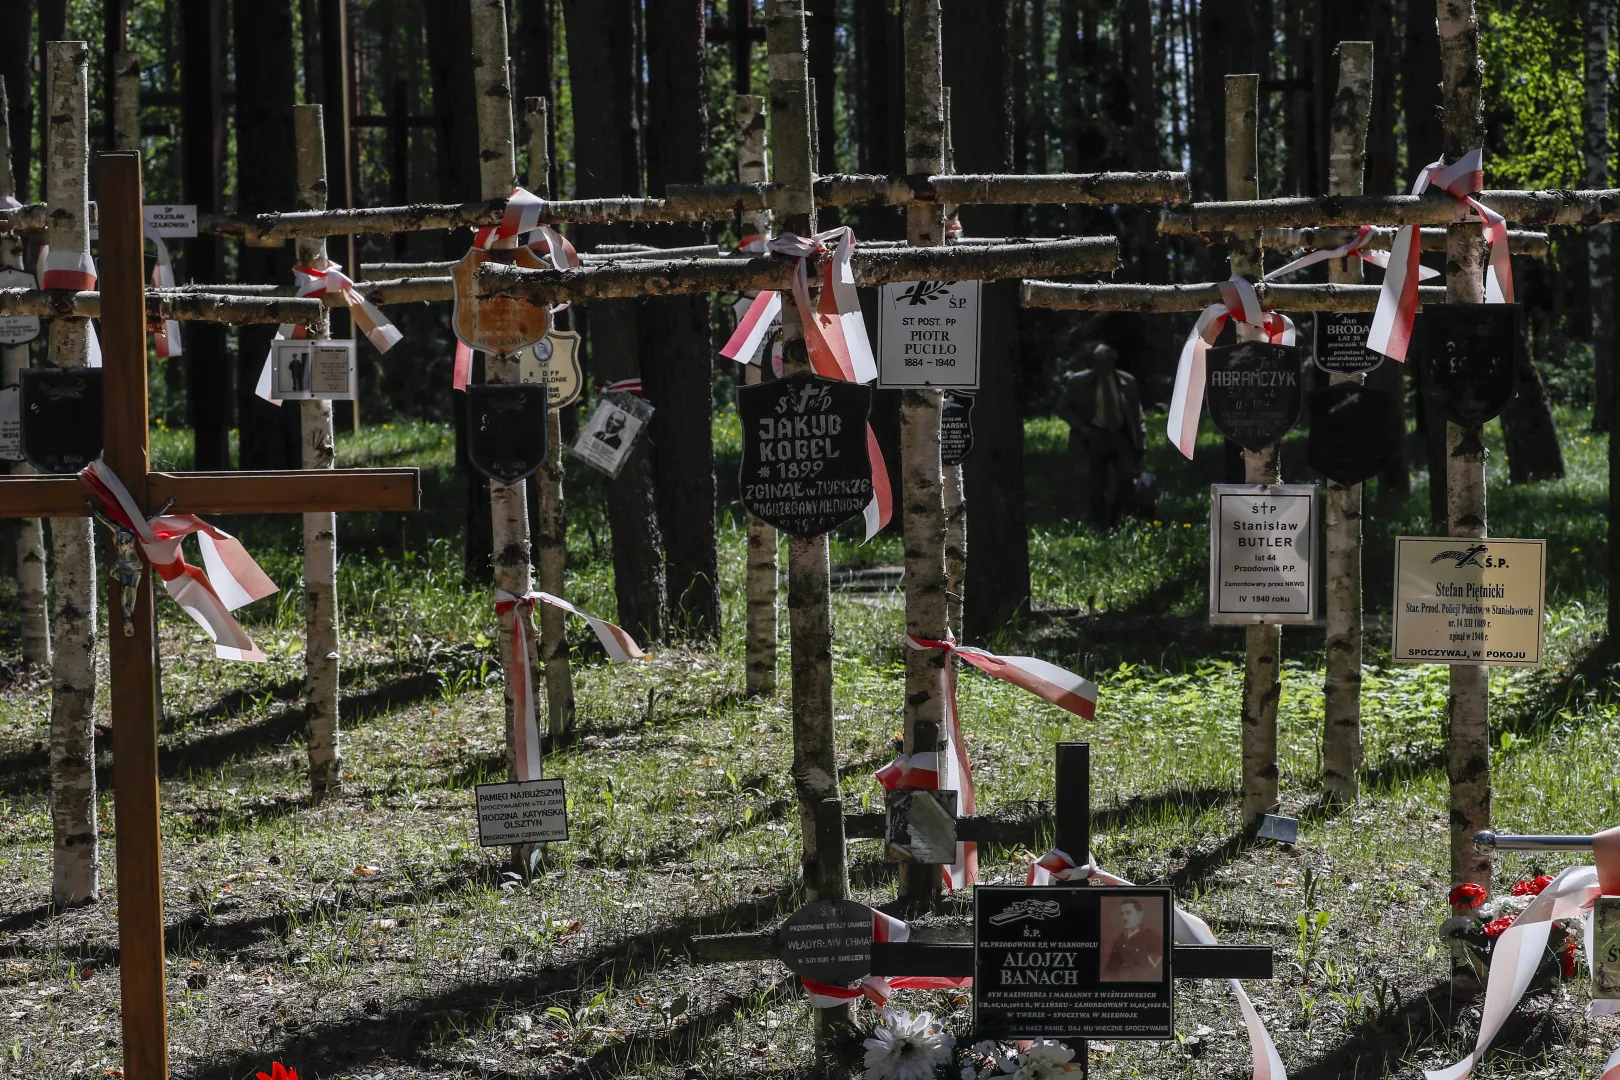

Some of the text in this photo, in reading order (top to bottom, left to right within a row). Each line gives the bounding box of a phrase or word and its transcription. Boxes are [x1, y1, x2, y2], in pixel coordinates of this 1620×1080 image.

[902, 317, 957, 327] ST. POST. PP
[1341, 316, 1357, 324] Jan
[1327, 324, 1370, 335] BRODA
[910, 330, 950, 341] PIOTR
[904, 343, 957, 355] PUCIŁO
[904, 358, 924, 367] 1884
[935, 358, 956, 367] 1940
[758, 414, 843, 440] JAKUB
[759, 437, 841, 462] KOBEL
[1233, 520, 1298, 531] Stanisław
[1238, 537, 1293, 547] BUTLER
[1485, 555, 1510, 568] Ś.P.
[1435, 582, 1505, 602] Stefan Piętnicki
[1405, 602, 1420, 613] Star.
[1421, 602, 1441, 614] Przod.
[1442, 603, 1461, 616] Policji
[1447, 618, 1492, 628] ur. 14 XII 1889 r.
[1484, 634, 1489, 642] r.
[1408, 648, 1468, 657] SPOCZYWAJ
[1486, 650, 1526, 659] POKOJU
[479, 788, 562, 802] PAMIĘCI NAJBLIŻSZYM
[482, 808, 564, 822] RODZINA KATYŃSKA
[503, 818, 543, 829] OLSZTYN
[521, 830, 550, 838] CZERWIEC
[789, 924, 824, 932] PRZODOWNIK
[787, 937, 841, 950] WŁADYSŁAW
[990, 941, 1037, 949] PRZODOWNIK
[1057, 941, 1099, 949] TARNOPOLU
[1002, 952, 1078, 968] ALOJZY
[1000, 969, 1079, 985] BANACH
[1100, 990, 1157, 998] WIŚNIEWSKICH
